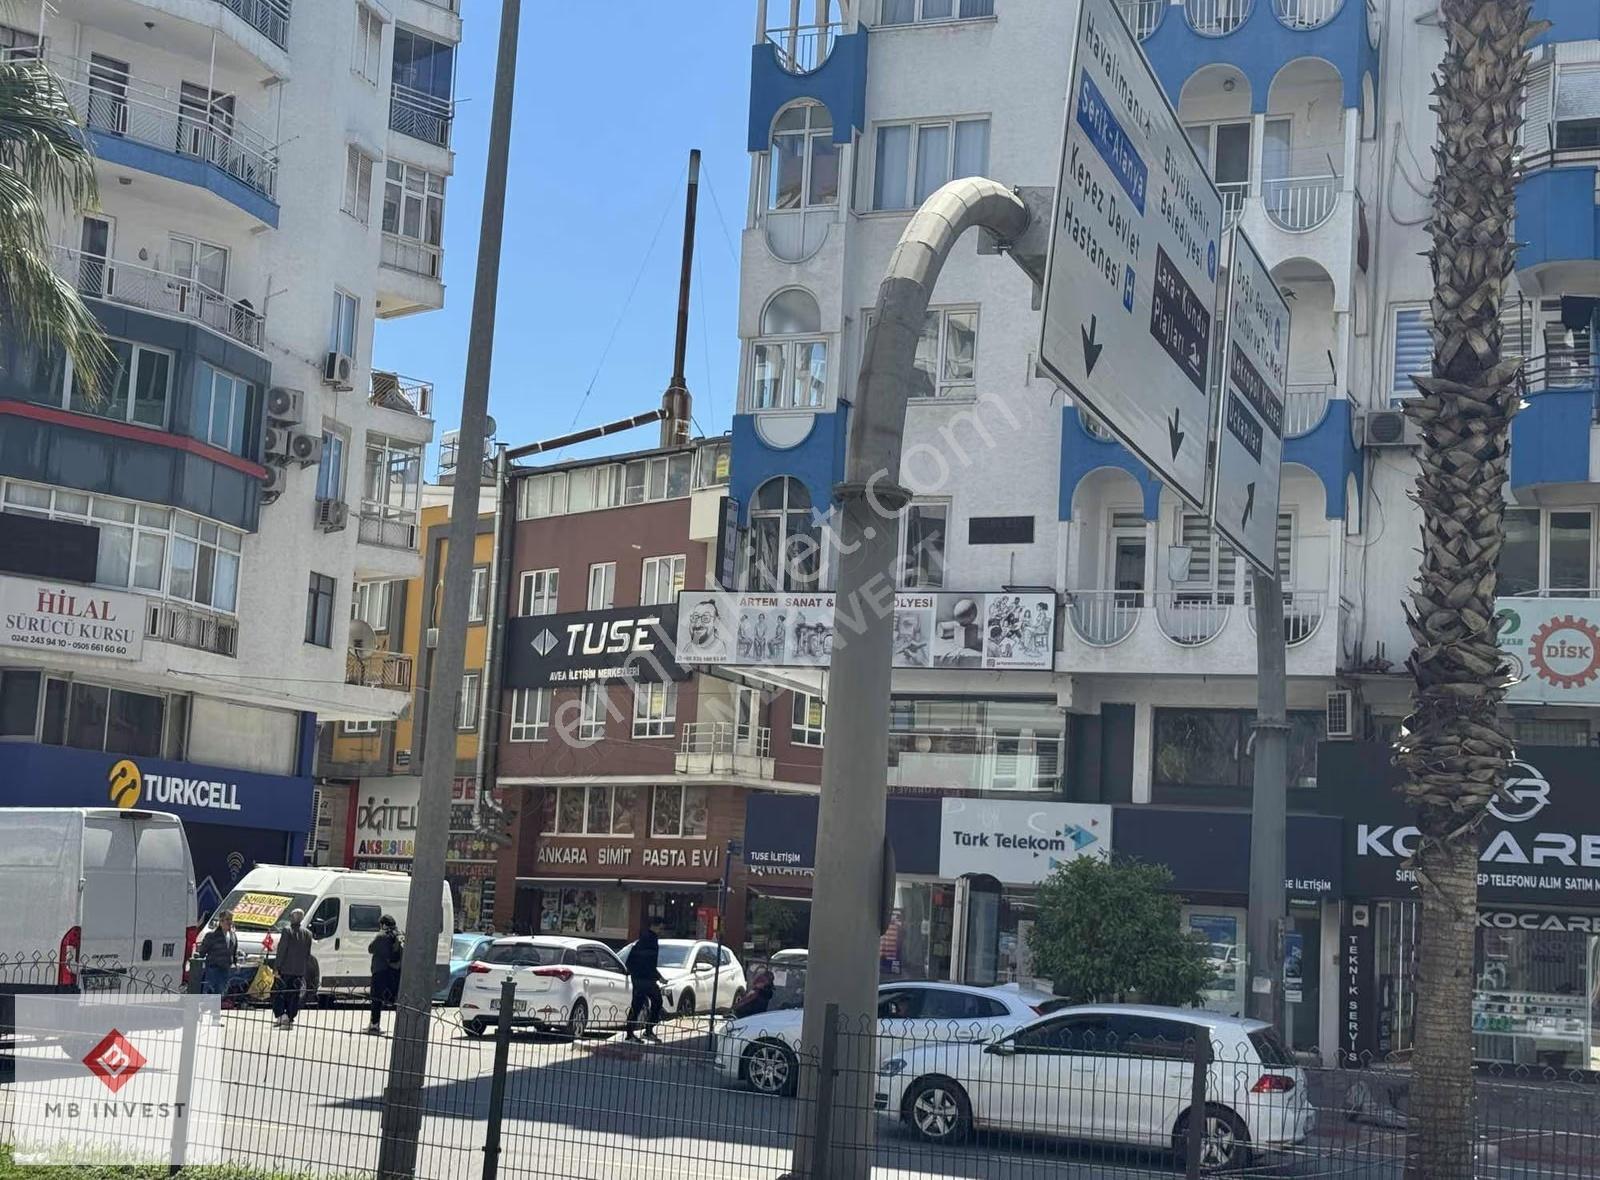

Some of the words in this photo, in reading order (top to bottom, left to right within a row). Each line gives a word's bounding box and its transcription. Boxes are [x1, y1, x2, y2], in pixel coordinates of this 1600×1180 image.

[1086, 11, 1143, 128] Havalimanı
[1070, 145, 1104, 213] Kepez
[1108, 195, 1140, 260] Devlet
[1161, 186, 1203, 269] Belediyesi
[1063, 196, 1121, 290] Hastanesi
[1153, 297, 1185, 355] Plajları
[36, 589, 117, 621] HİLAL
[739, 597, 779, 607] ARTEM
[785, 597, 822, 608] SANAT
[826, 598, 834, 608] &
[896, 596, 933, 608] LYESİ
[5, 613, 77, 637] SÜRÜCÜ
[80, 623, 136, 644] KURSU
[567, 617, 660, 656] TUSE
[11, 634, 29, 643] 0242
[30, 636, 45, 644] 243
[46, 638, 56, 646] 94
[58, 639, 67, 648] 10
[90, 643, 103, 652] 661
[104, 644, 115, 653] 60
[116, 645, 127, 654] 60
[1545, 639, 1591, 659] DİSK
[549, 670, 567, 681] AVEA
[568, 666, 597, 681] İLETİŞİM
[598, 664, 640, 679] MERKEZLERİ
[143, 774, 241, 811] TURKCELL
[358, 839, 414, 856] AKSESUA
[953, 830, 989, 848] Türk
[994, 833, 1065, 851] Telekom
[537, 847, 588, 864] ANKARA
[598, 845, 632, 865] SİMİT
[642, 849, 687, 867] PASTA
[691, 845, 719, 867] EVİ
[751, 851, 769, 861] TUSE
[770, 851, 800, 864] İLETİŞİM
[1295, 878, 1331, 892] İLETİŞİM
[1490, 874, 1537, 888] TELEFONU
[1538, 876, 1561, 889] ALIM
[1565, 877, 1593, 891] SATIM
